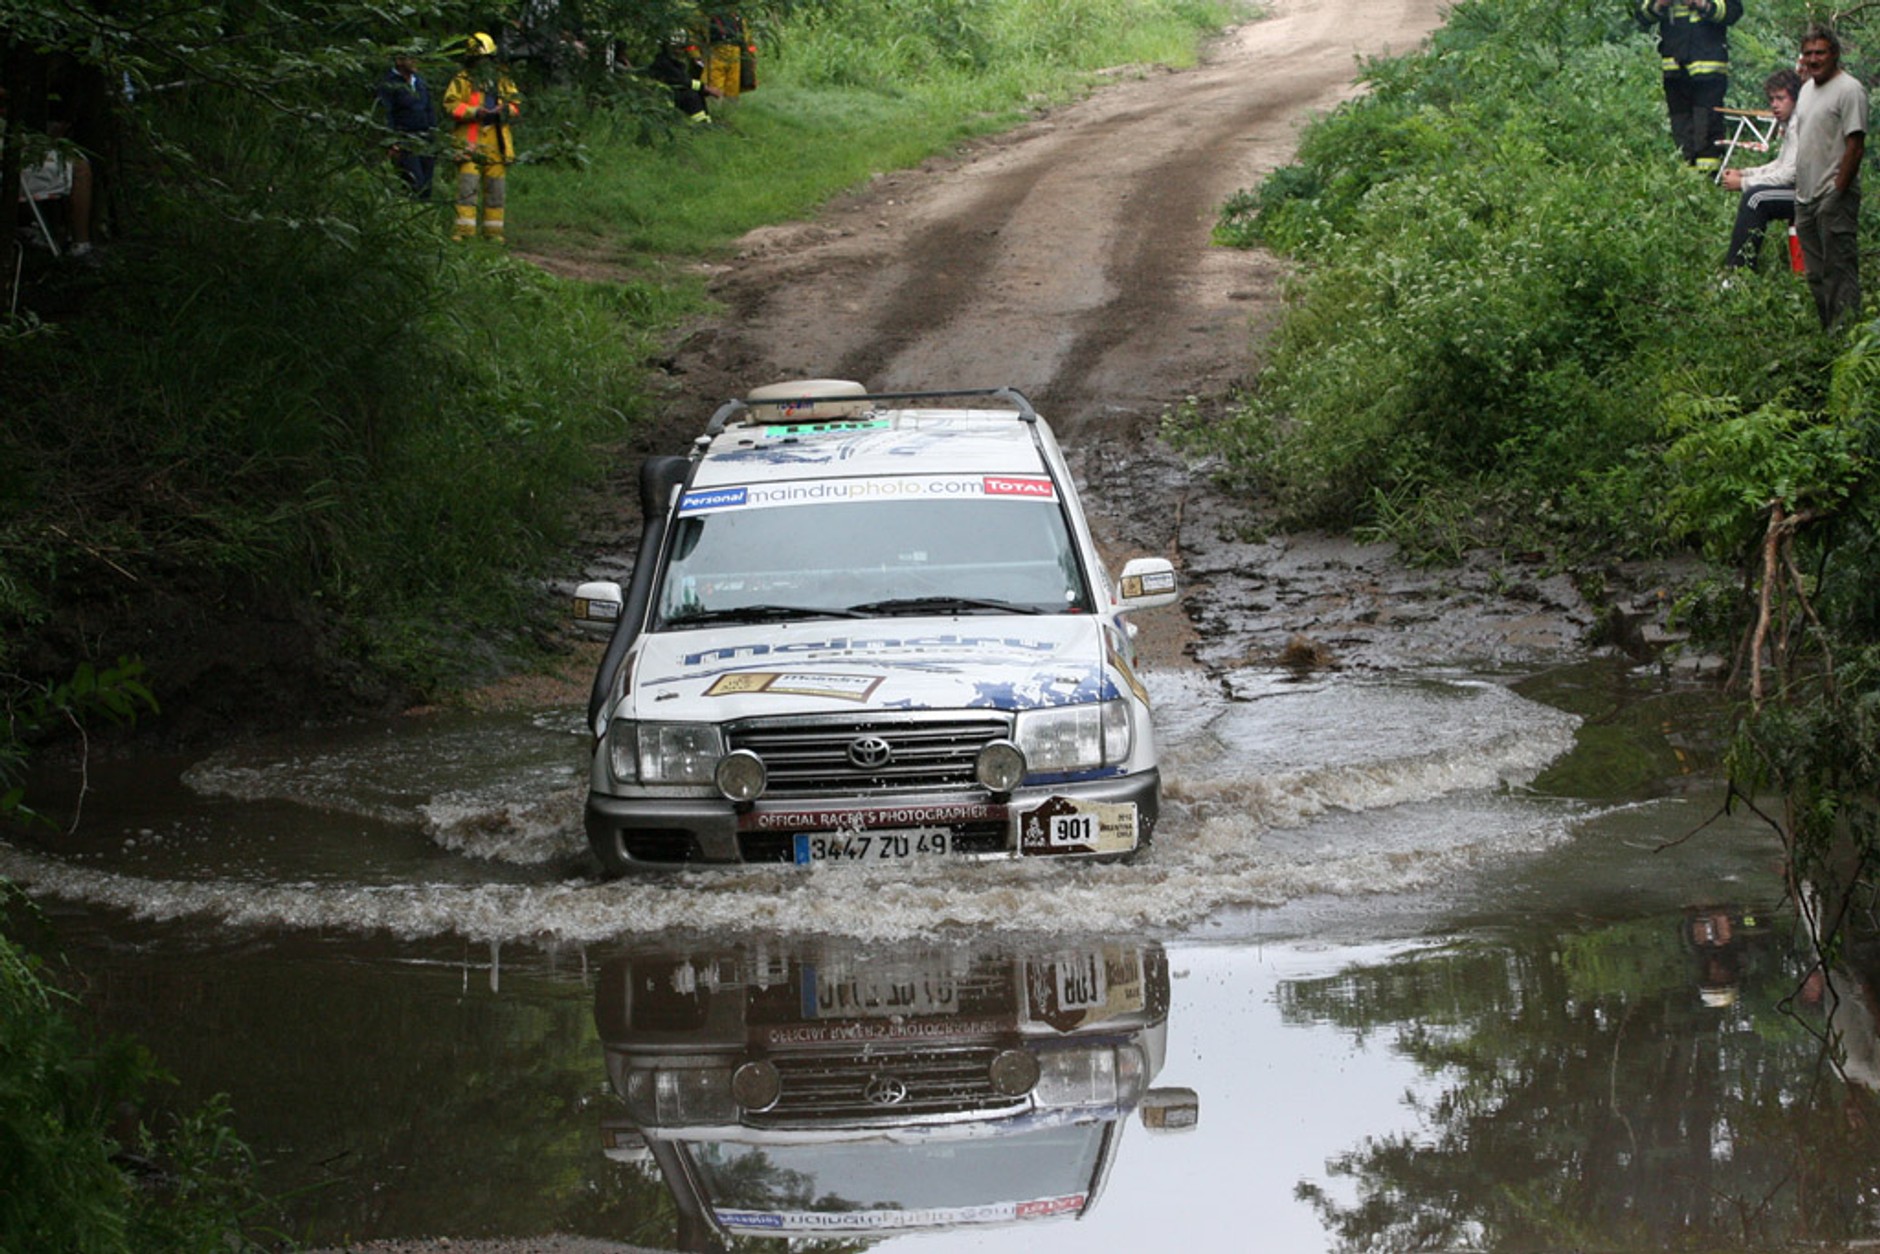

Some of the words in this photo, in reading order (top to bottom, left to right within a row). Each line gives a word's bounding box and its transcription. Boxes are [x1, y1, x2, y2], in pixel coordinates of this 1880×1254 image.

[748, 479, 984, 503] maindruphoto.com
[986, 479, 1050, 494] TOTAL
[682, 490, 745, 507] Personal
[758, 812, 816, 828] OFFICIAL
[879, 805, 988, 823] PHOTOGRAPHER
[1057, 817, 1091, 840] 901
[811, 836, 871, 861] 3447
[879, 834, 909, 859] ZU
[915, 833, 946, 856] 49
